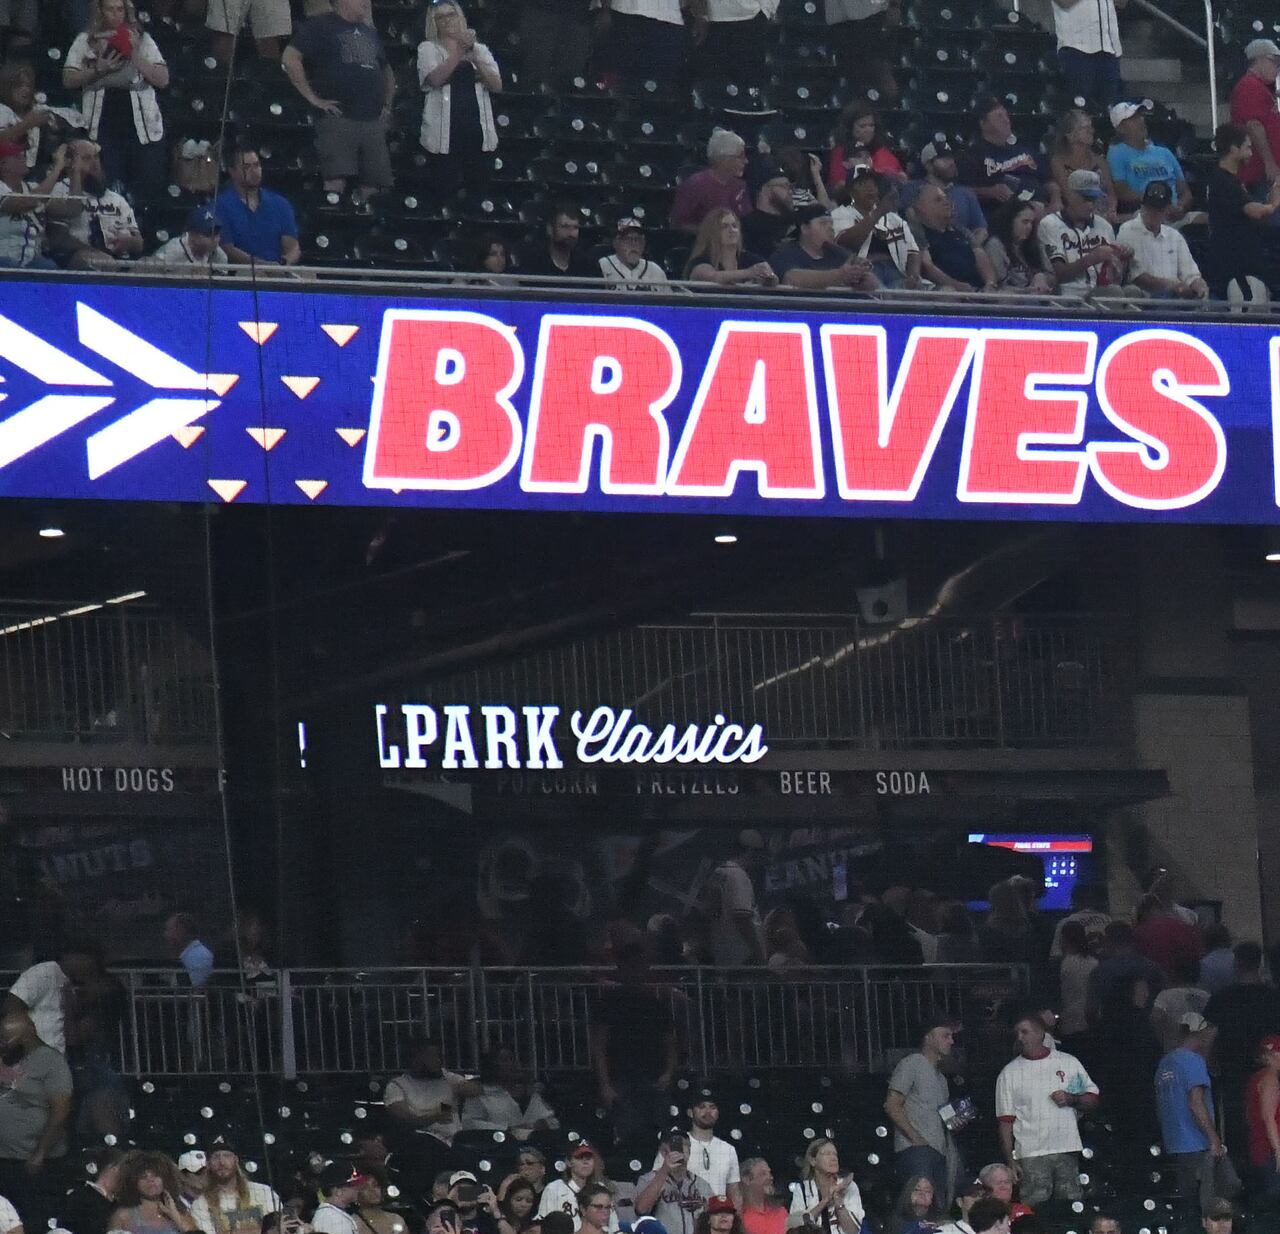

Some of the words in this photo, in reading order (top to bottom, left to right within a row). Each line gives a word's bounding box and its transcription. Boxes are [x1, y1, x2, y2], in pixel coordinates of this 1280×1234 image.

[363, 310, 1230, 511] BRAVES
[376, 704, 563, 769] LPARK
[571, 706, 769, 763] Classics
[62, 768, 104, 791] HOT
[119, 768, 174, 791] DOGS
[780, 771, 831, 794] BEER
[877, 771, 930, 794] SODA
